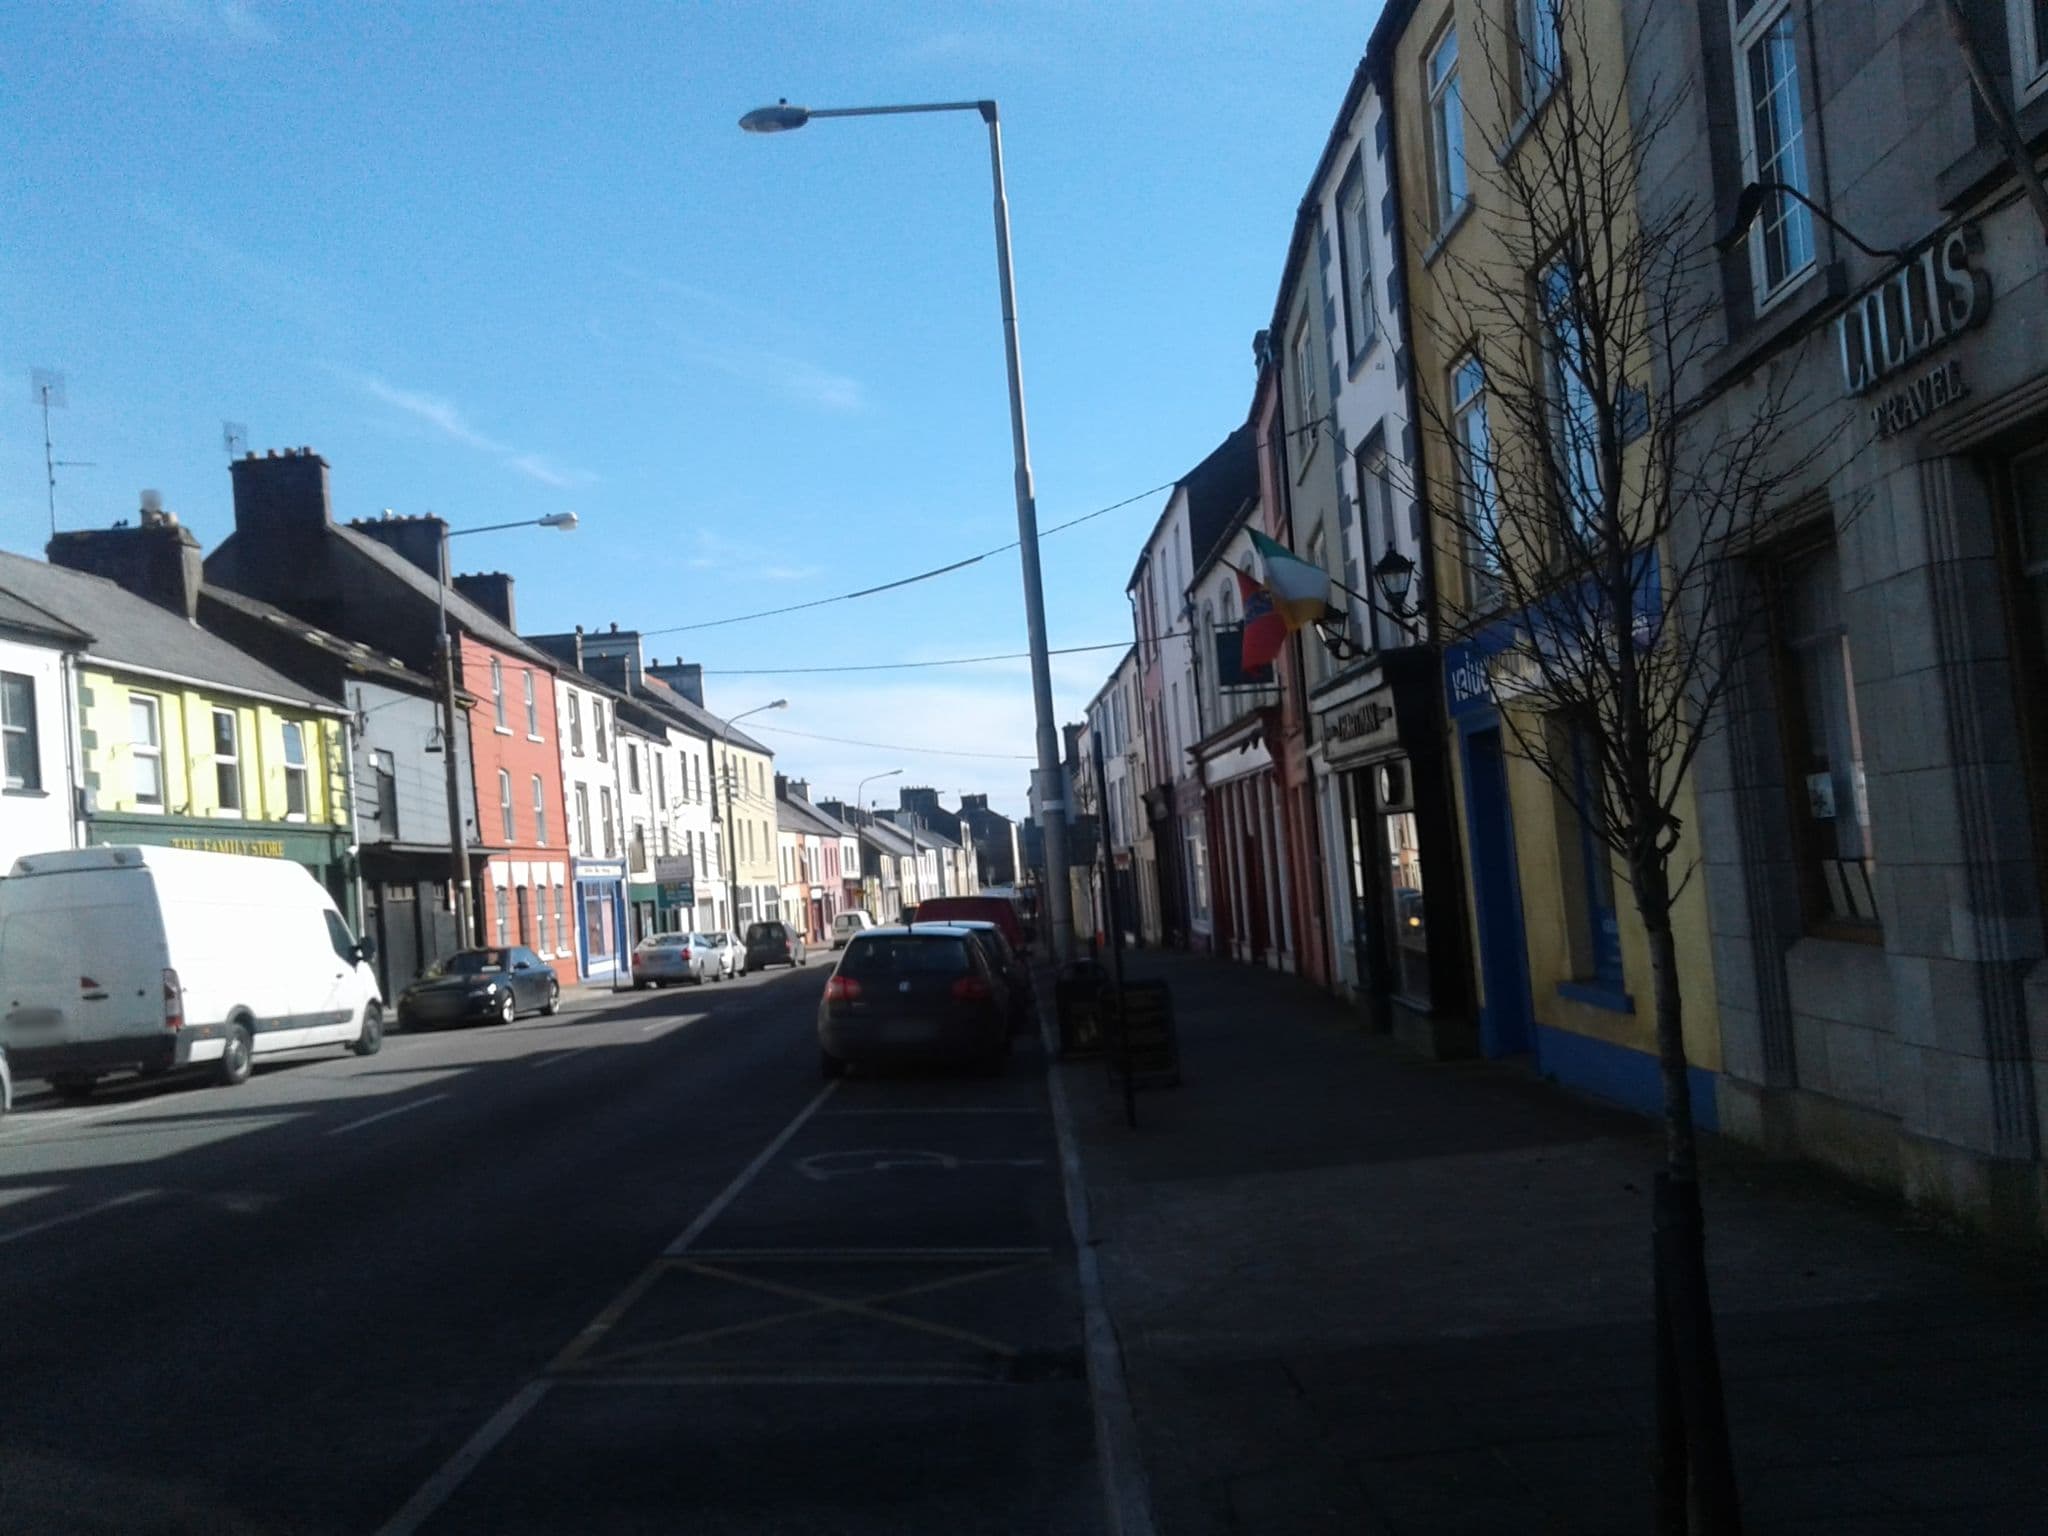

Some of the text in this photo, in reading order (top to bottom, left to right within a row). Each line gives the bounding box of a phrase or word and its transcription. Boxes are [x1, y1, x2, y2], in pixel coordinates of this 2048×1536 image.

[1836, 226, 1983, 398] LILLIS
[1872, 364, 1965, 437] TRAVEL
[250, 841, 285, 857] STORE
